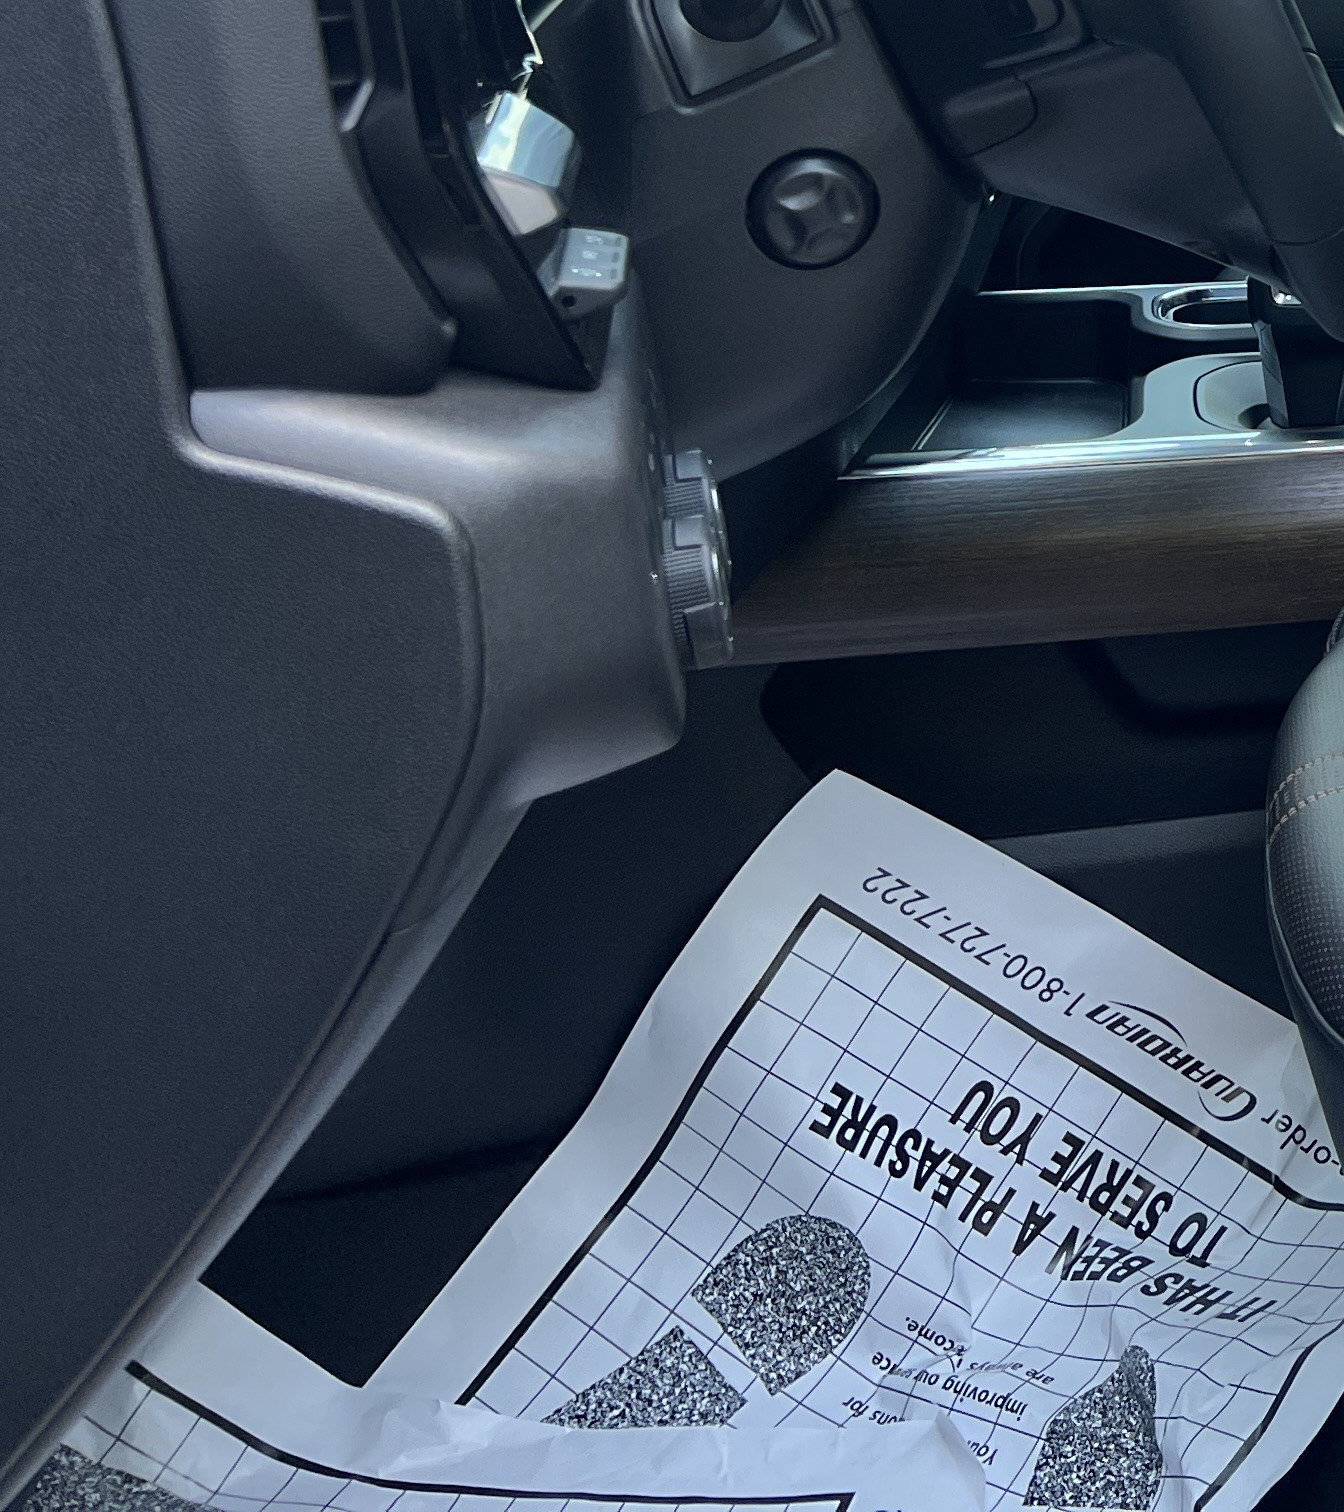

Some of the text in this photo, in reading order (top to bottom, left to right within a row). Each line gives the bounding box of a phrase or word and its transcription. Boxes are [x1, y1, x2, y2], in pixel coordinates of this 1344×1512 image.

[862, 867, 1085, 1017] 1-800-727-7222
[1085, 1001, 1257, 1122] GUARDIAN
[809, 1081, 1278, 1323] IT HAS BEEN A PLEASURE
[948, 1080, 1228, 1269] TO SERVE YOU
[842, 1397, 869, 1419] for
[942, 1375, 1028, 1422] improving
[1025, 1369, 1055, 1386] are
[967, 1440, 998, 1466] You
